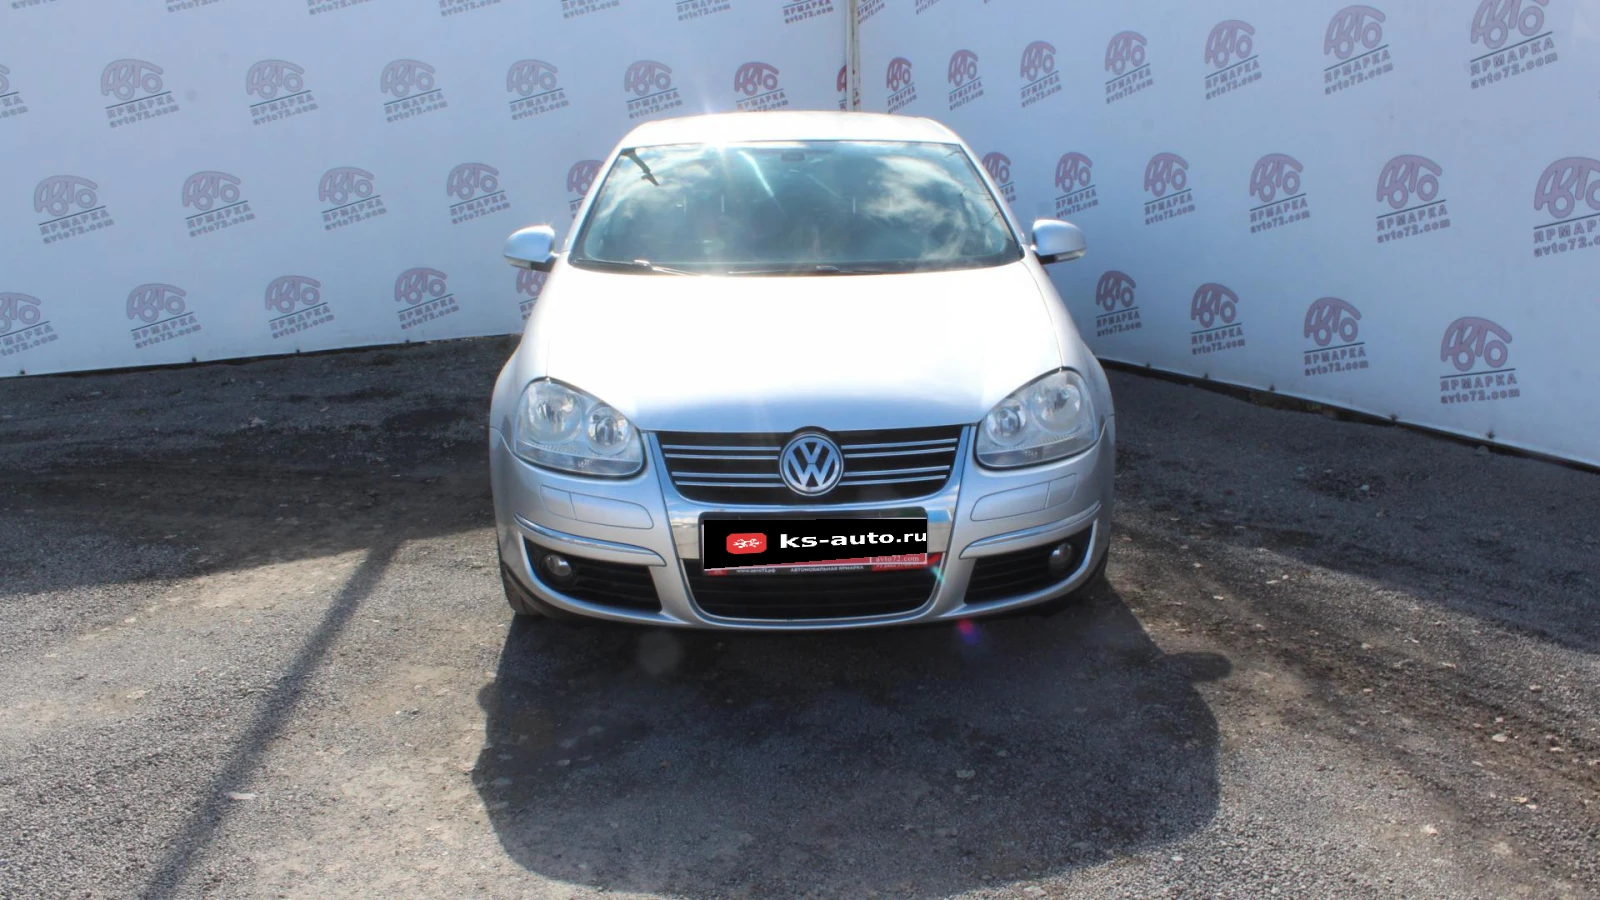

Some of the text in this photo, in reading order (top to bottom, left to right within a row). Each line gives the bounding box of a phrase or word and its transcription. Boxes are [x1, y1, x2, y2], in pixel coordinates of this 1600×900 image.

[785, 6, 835, 24] avto72.com
[1470, 37, 1555, 76] ЯРМАРКА
[1471, 52, 1558, 89] avto72.com
